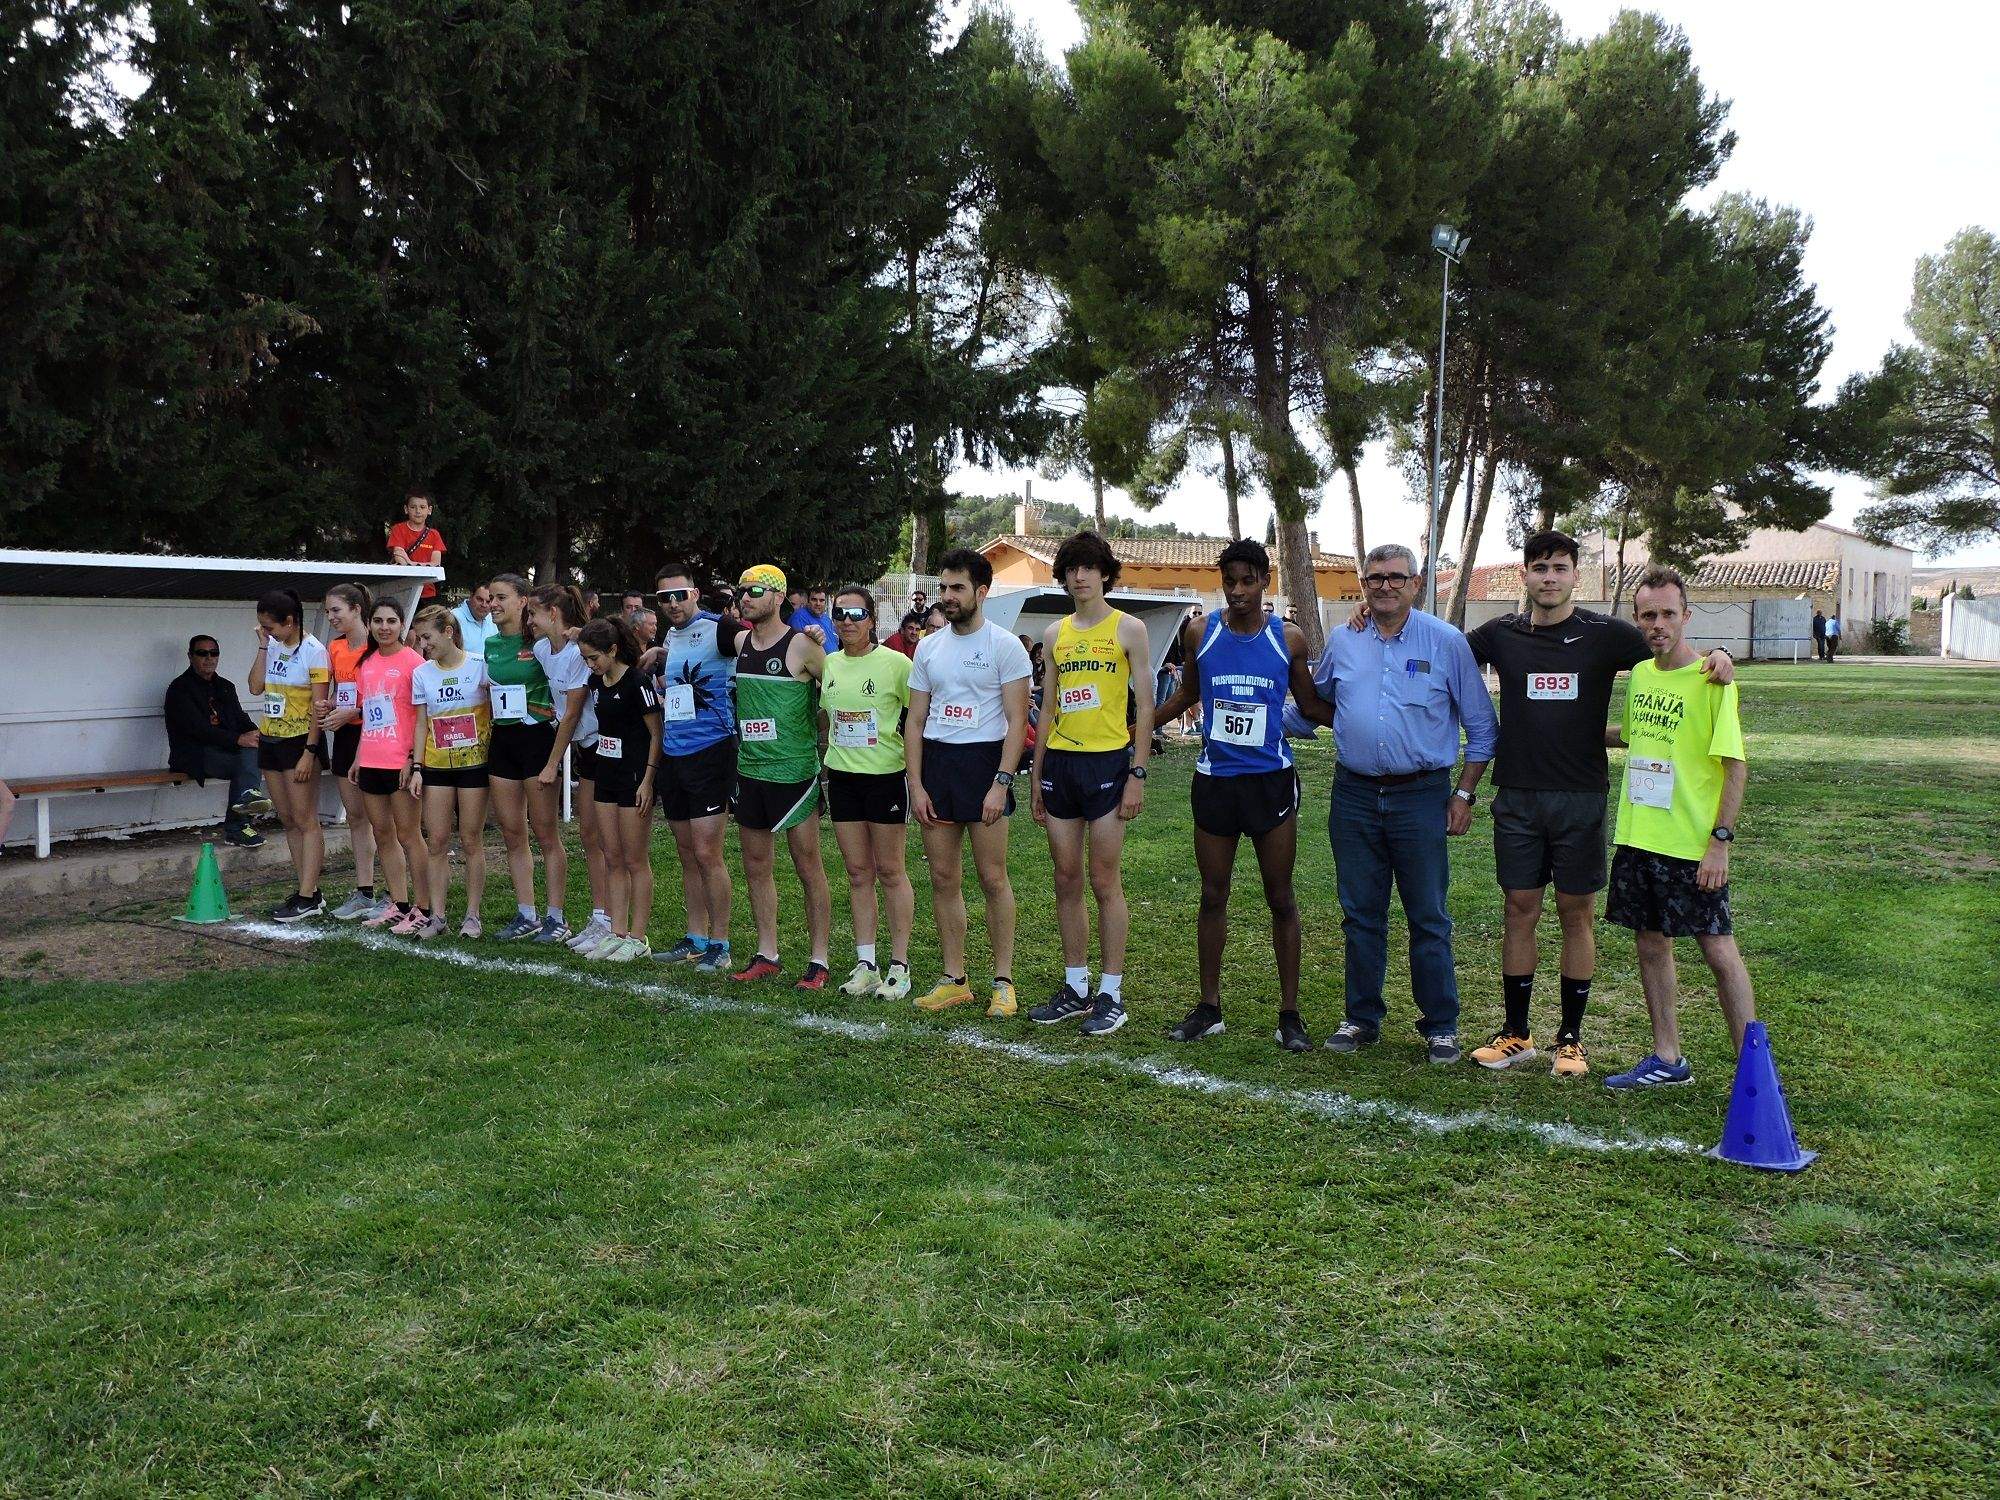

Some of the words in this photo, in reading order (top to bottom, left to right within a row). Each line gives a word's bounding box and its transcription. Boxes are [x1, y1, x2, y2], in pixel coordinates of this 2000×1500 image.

[1211, 674, 1246, 687] POLISPORTIVA
[1245, 675, 1268, 689] ATLETICA
[1535, 676, 1570, 690] 693
[338, 691, 349, 702] 56
[438, 686, 463, 698] 10K
[1065, 688, 1092, 704] 696
[1231, 685, 1255, 697] TORINO
[436, 695, 465, 704] ZARAGOZA
[499, 692, 507, 710] 1
[671, 697, 681, 710] 18
[1633, 693, 1684, 719] FRANJA
[945, 705, 973, 720] 694
[745, 721, 769, 734] 692
[847, 724, 854, 733] 5
[1224, 714, 1254, 736] 567
[443, 732, 467, 741] ISABEL
